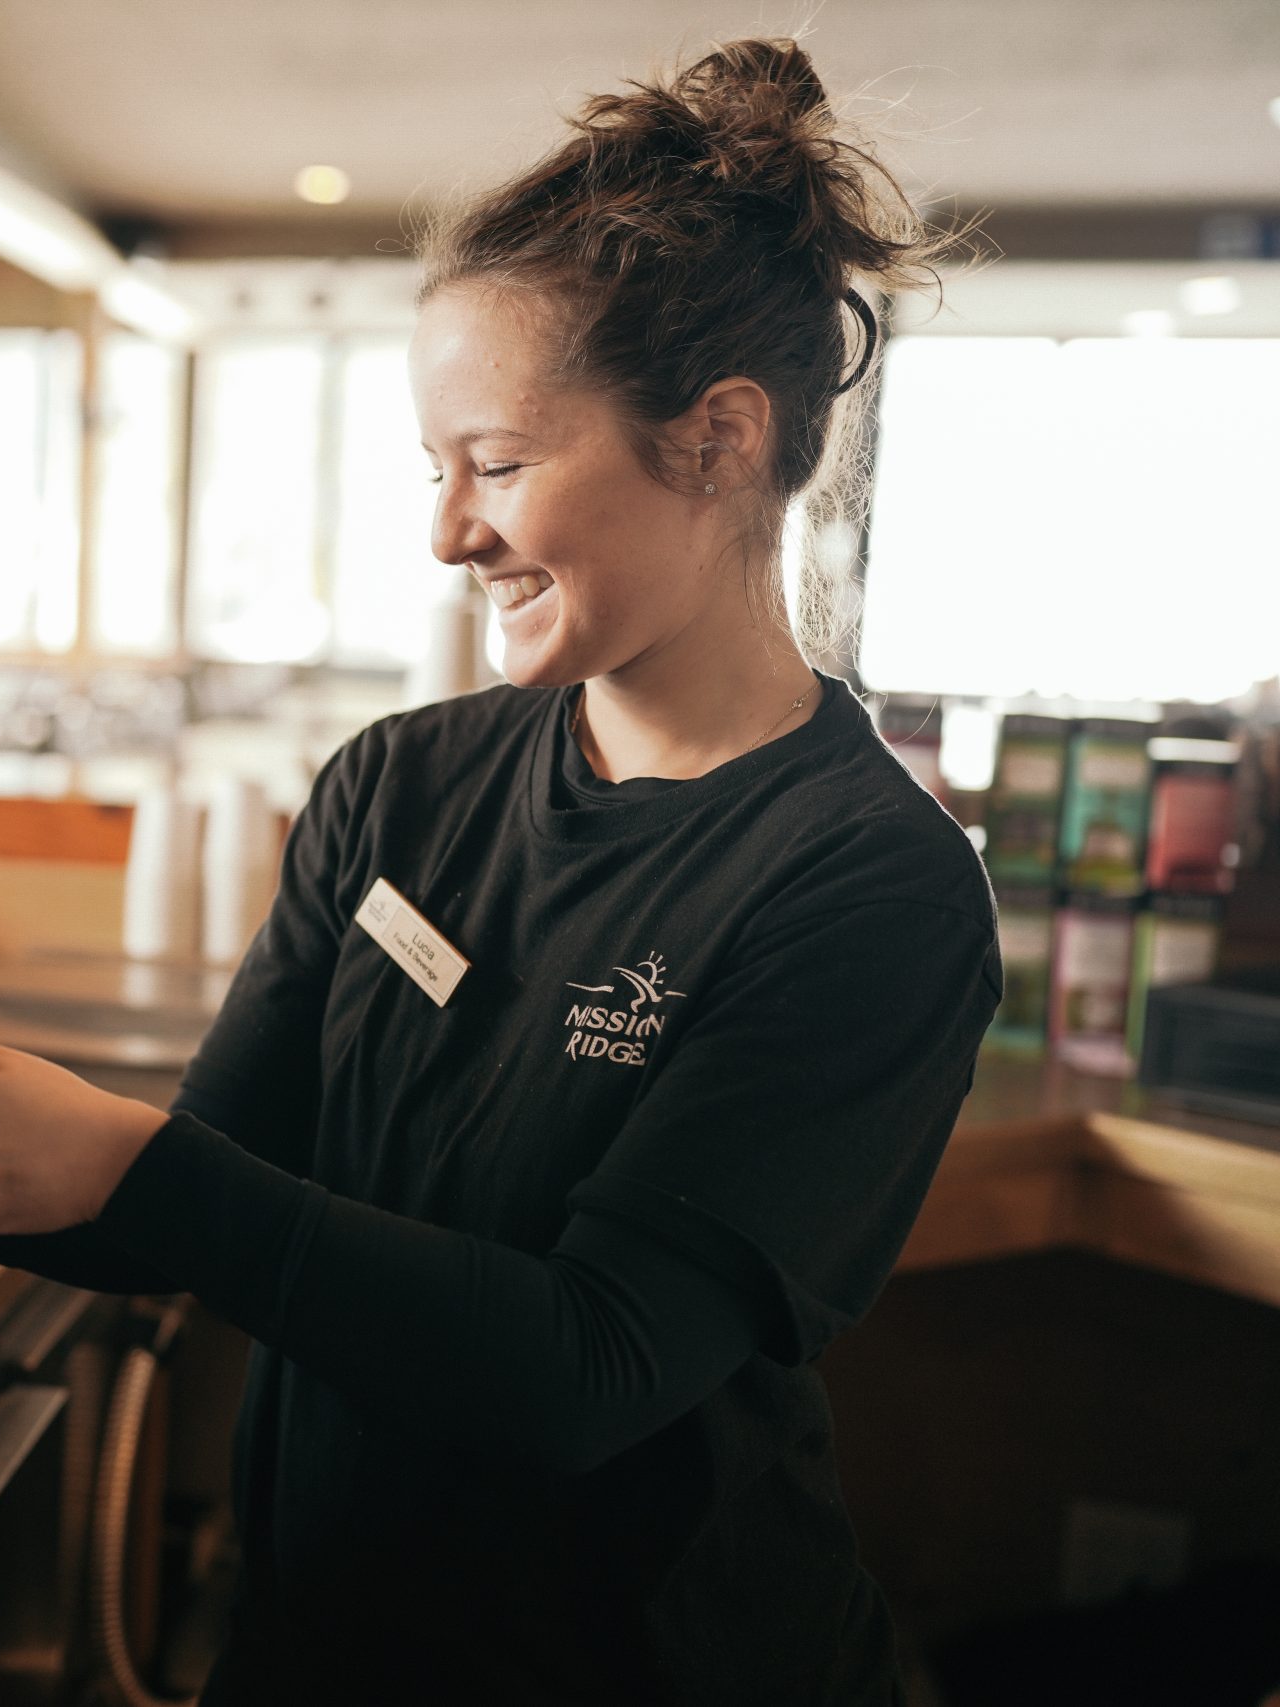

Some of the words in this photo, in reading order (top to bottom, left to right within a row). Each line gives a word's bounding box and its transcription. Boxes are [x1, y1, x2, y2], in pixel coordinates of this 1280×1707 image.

[393, 932, 408, 951] Food
[412, 952, 438, 982] Beverage
[412, 933, 435, 961] Lucia
[564, 1030, 647, 1066] RIDGE
